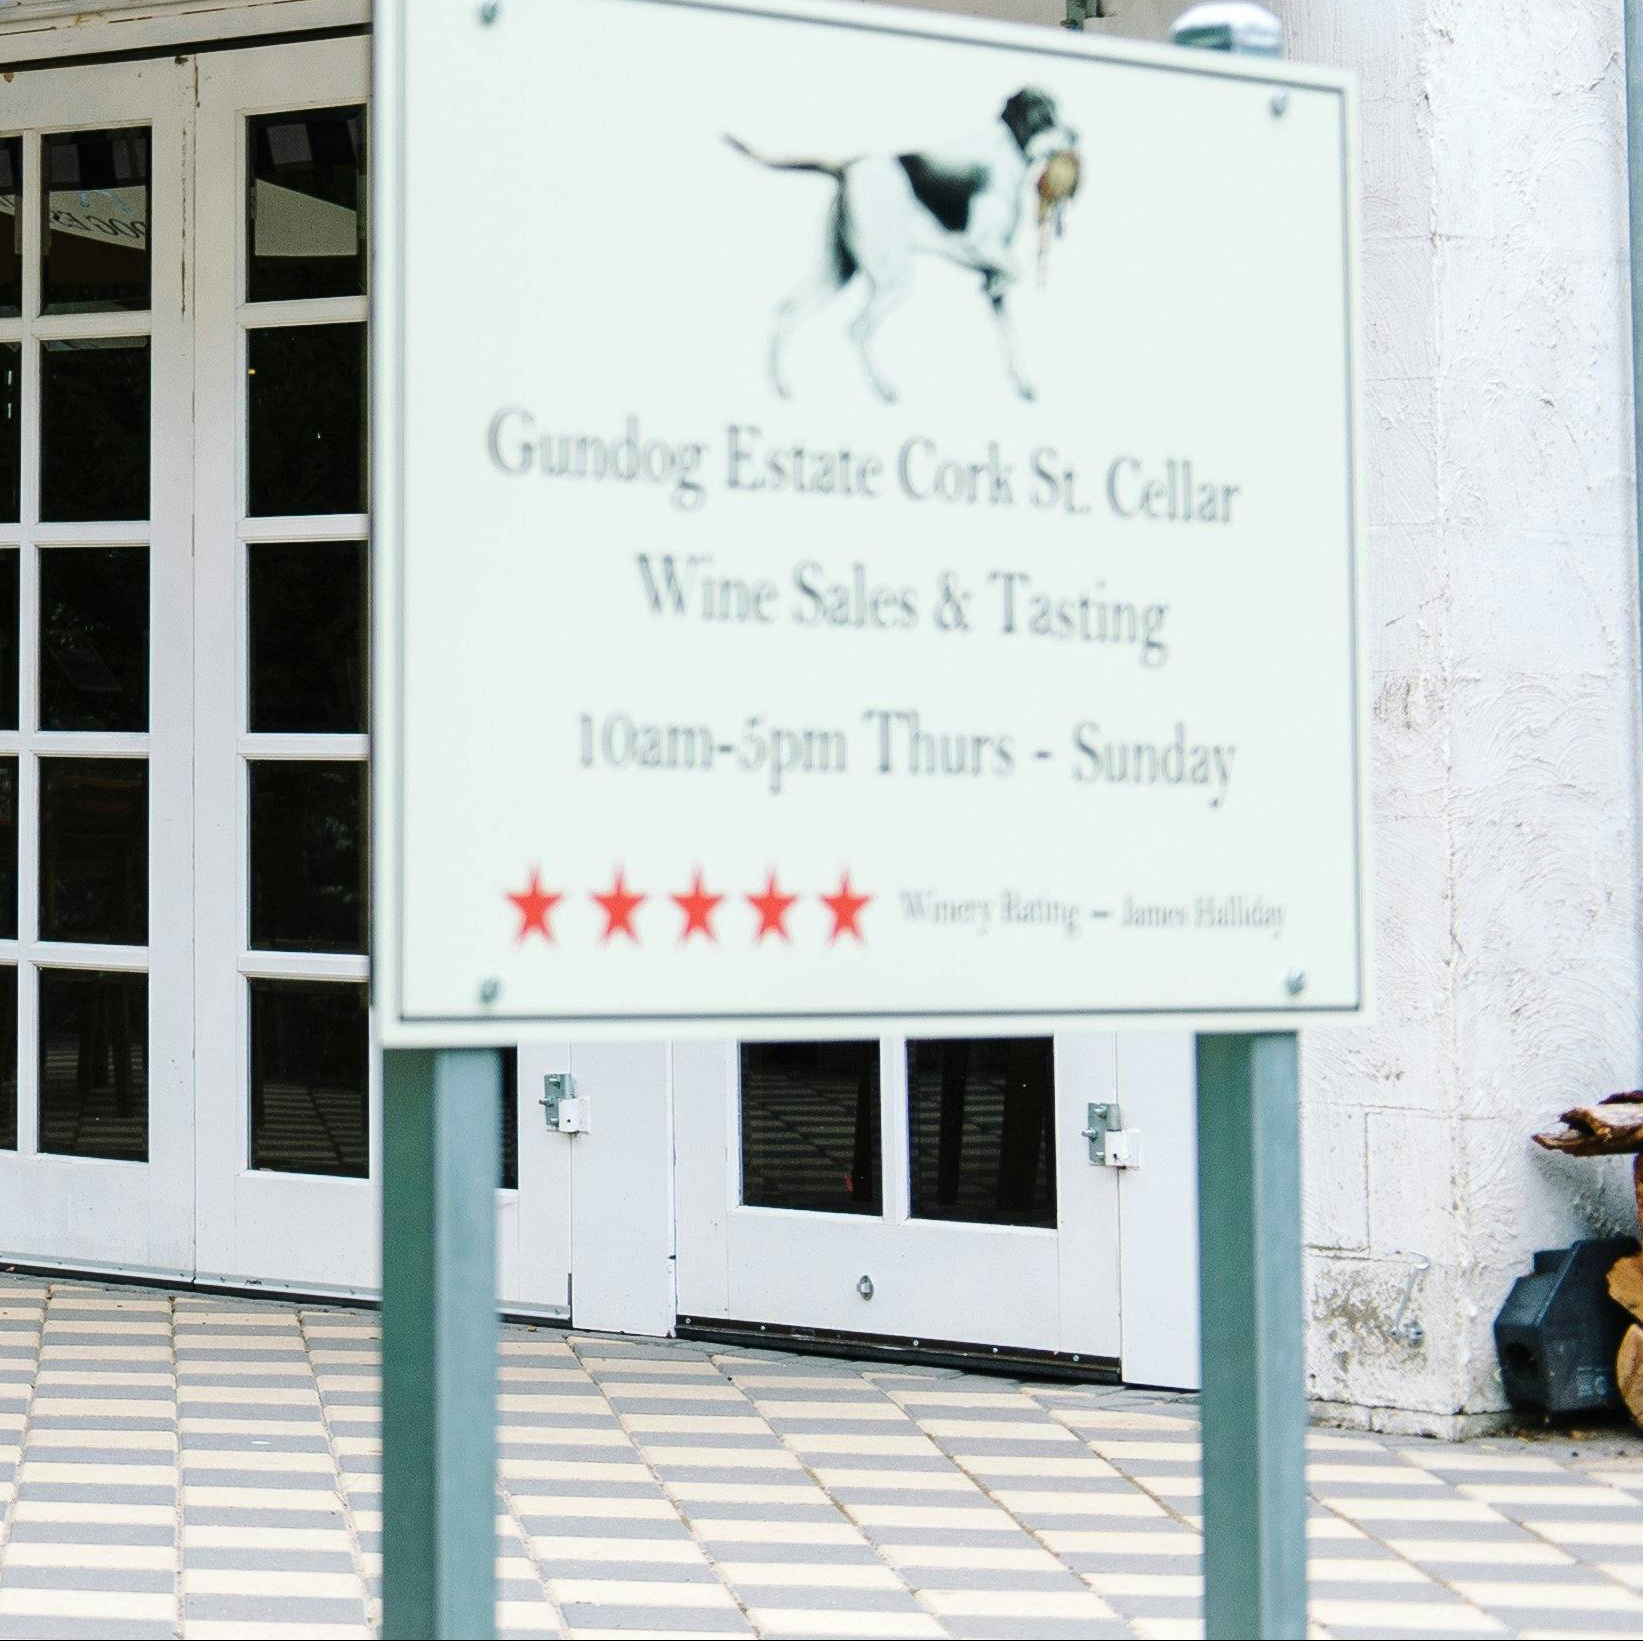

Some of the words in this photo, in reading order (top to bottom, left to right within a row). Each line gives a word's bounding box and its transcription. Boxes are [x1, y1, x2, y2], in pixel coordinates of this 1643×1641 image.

[485, 407, 706, 510] Gundog
[725, 423, 883, 498] Estate
[896, 436, 1014, 507] Cork
[1030, 448, 1090, 514] St.
[1105, 455, 1241, 525] Cellar
[635, 552, 778, 625] Wine
[793, 562, 917, 630] Sales
[933, 570, 972, 633] &
[987, 569, 1169, 668] Tasting
[579, 712, 848, 796] 10am-5pm
[862, 709, 1015, 778] Thurs
[1072, 721, 1236, 809] Sunday
[899, 889, 992, 935] Winery
[1001, 889, 1081, 939] Rating
